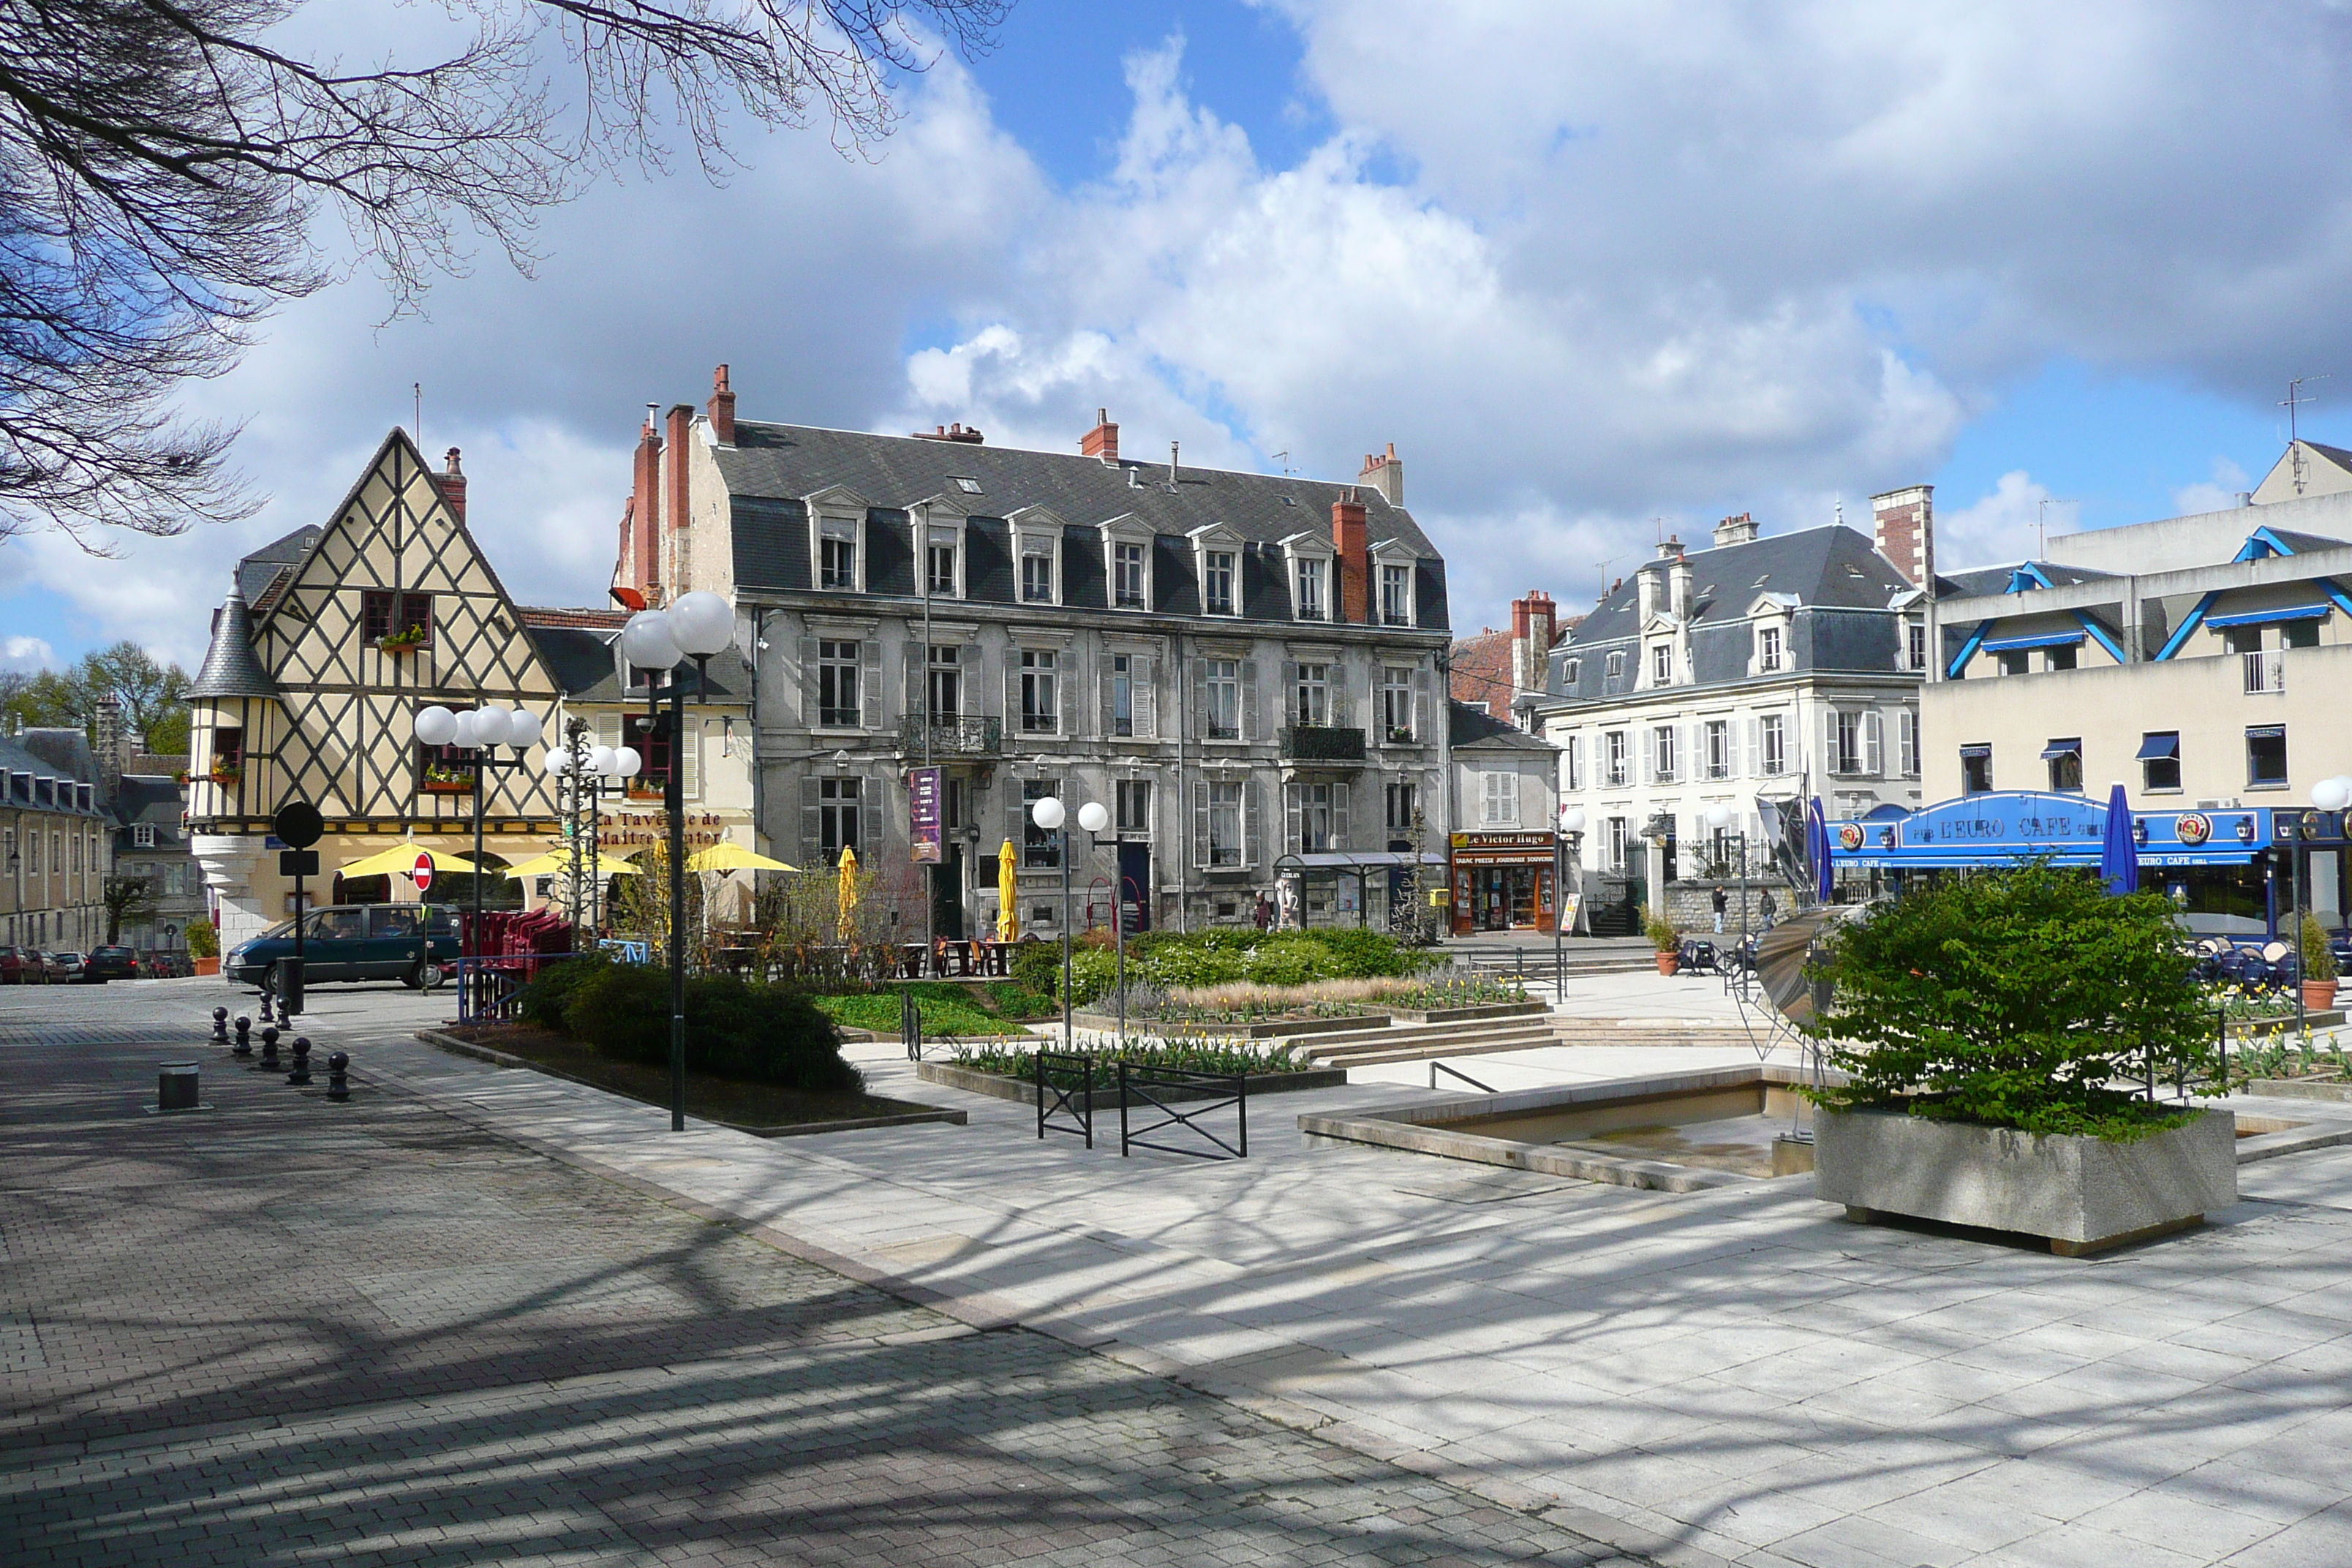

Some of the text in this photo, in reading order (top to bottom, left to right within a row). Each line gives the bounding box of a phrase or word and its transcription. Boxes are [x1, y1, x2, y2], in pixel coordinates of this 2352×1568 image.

[618, 813, 696, 826] Tavee
[701, 813, 721, 826] de
[1913, 829, 1934, 839] PUB
[1940, 818, 2005, 839] L'EURO
[2019, 817, 2071, 837] CAFE
[596, 829, 654, 845] Maître
[1467, 834, 1544, 845] Le Victor Hugo
[1836, 859, 1858, 867] L'EURO
[1862, 859, 1879, 867] CAFE
[2167, 856, 2190, 865] CAFE
